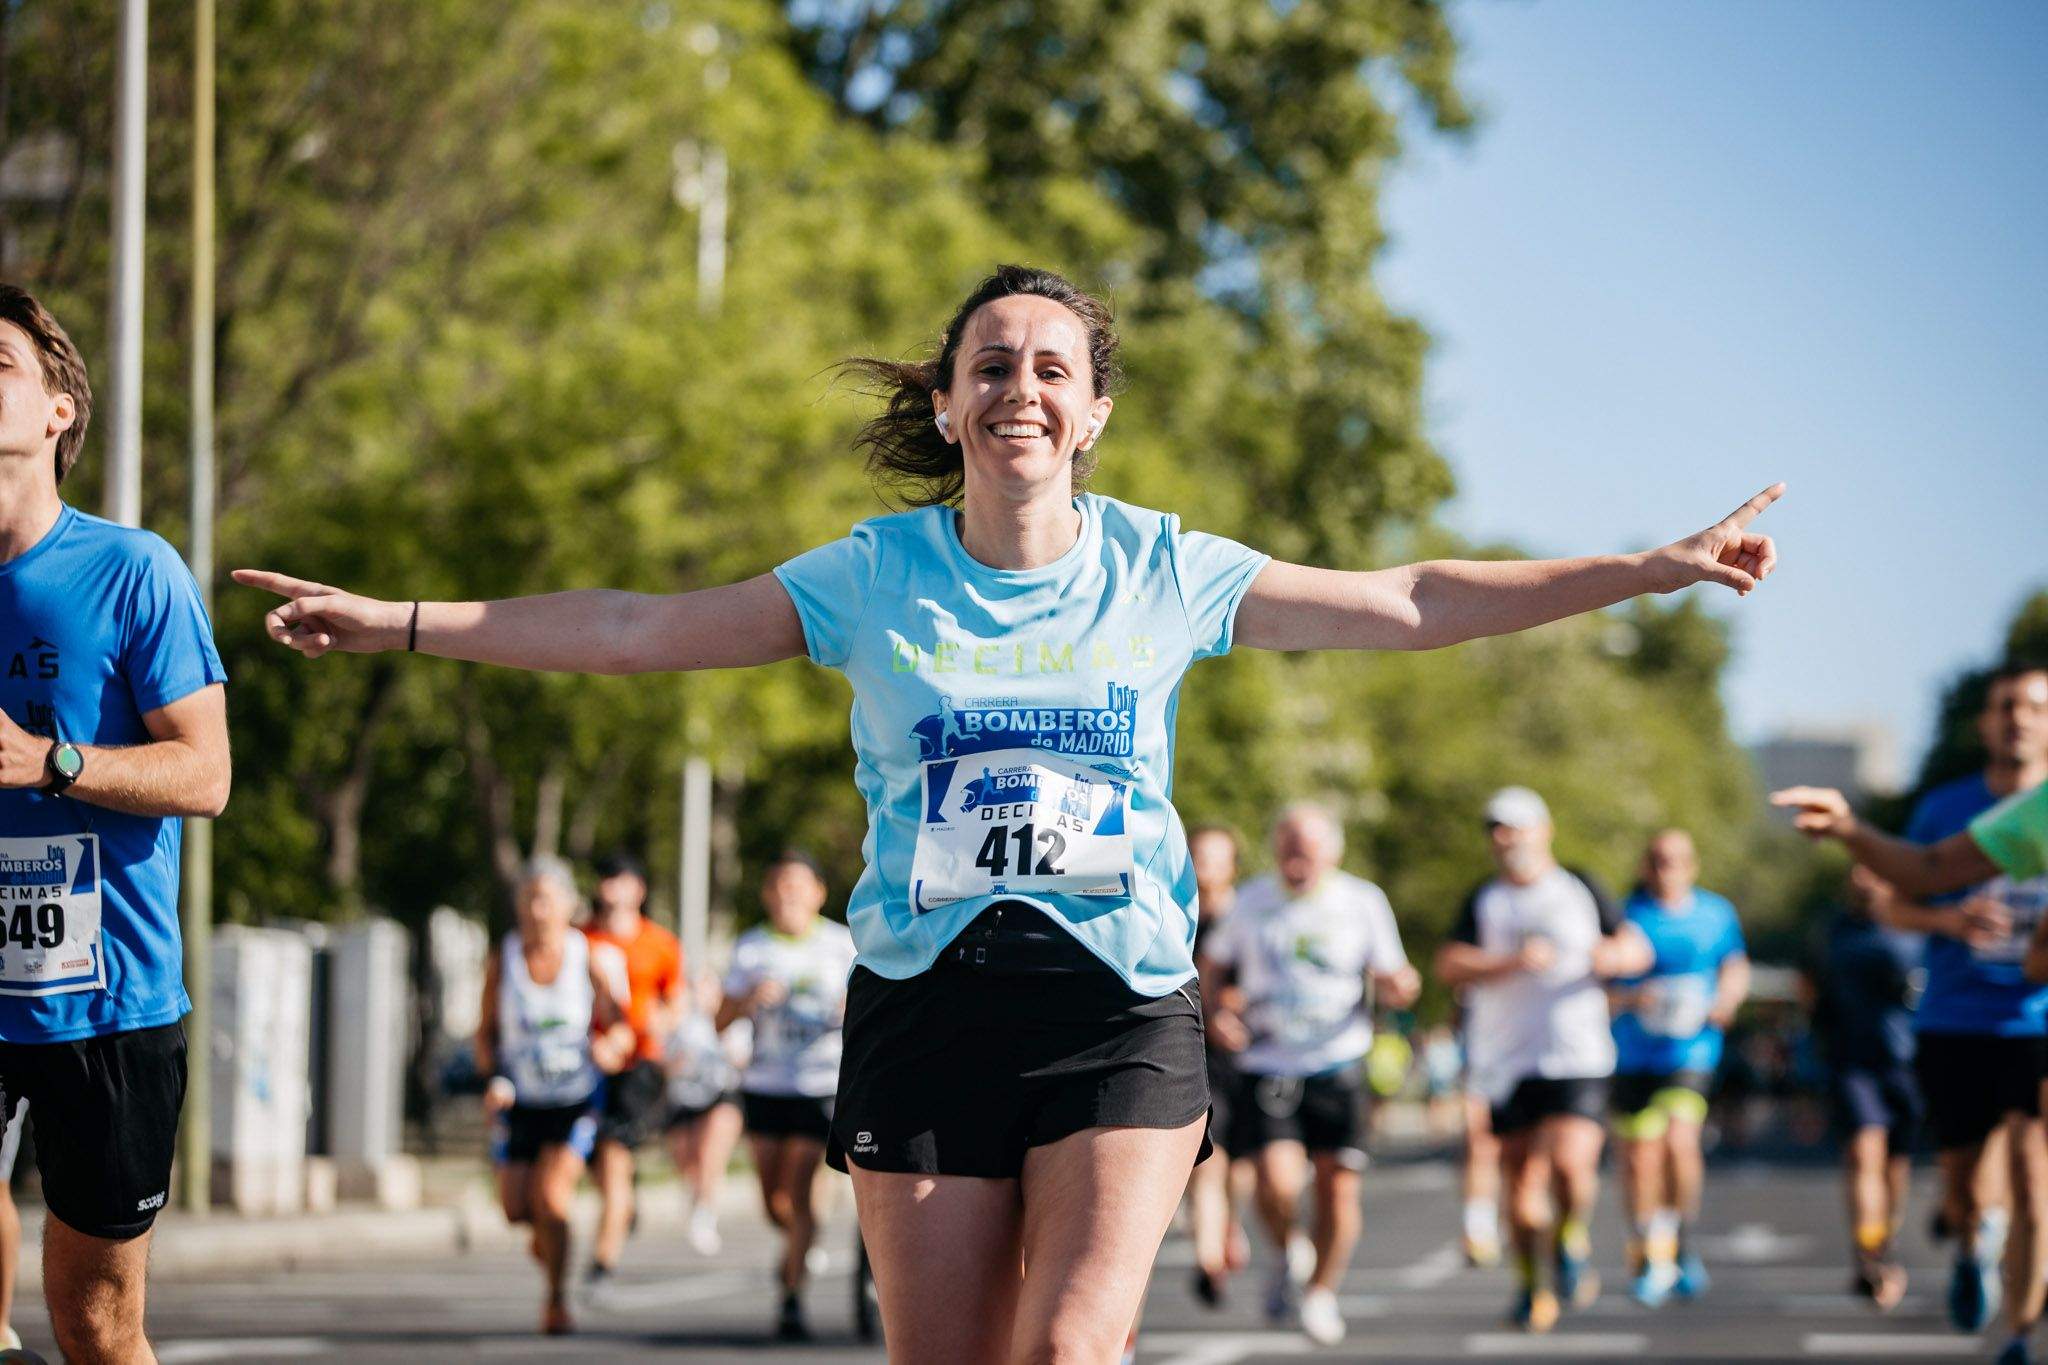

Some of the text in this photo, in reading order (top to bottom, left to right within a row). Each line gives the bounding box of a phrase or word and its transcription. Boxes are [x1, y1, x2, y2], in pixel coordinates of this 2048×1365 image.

[892, 636, 1156, 675] DECIMAS
[964, 696, 1019, 708] CARRERA
[964, 709, 1131, 733] BOMBEROS
[1030, 731, 1130, 756] de MADRID
[997, 765, 1033, 775] CARRERA
[981, 803, 1084, 833] DECIAS
[975, 822, 1067, 877] 412
